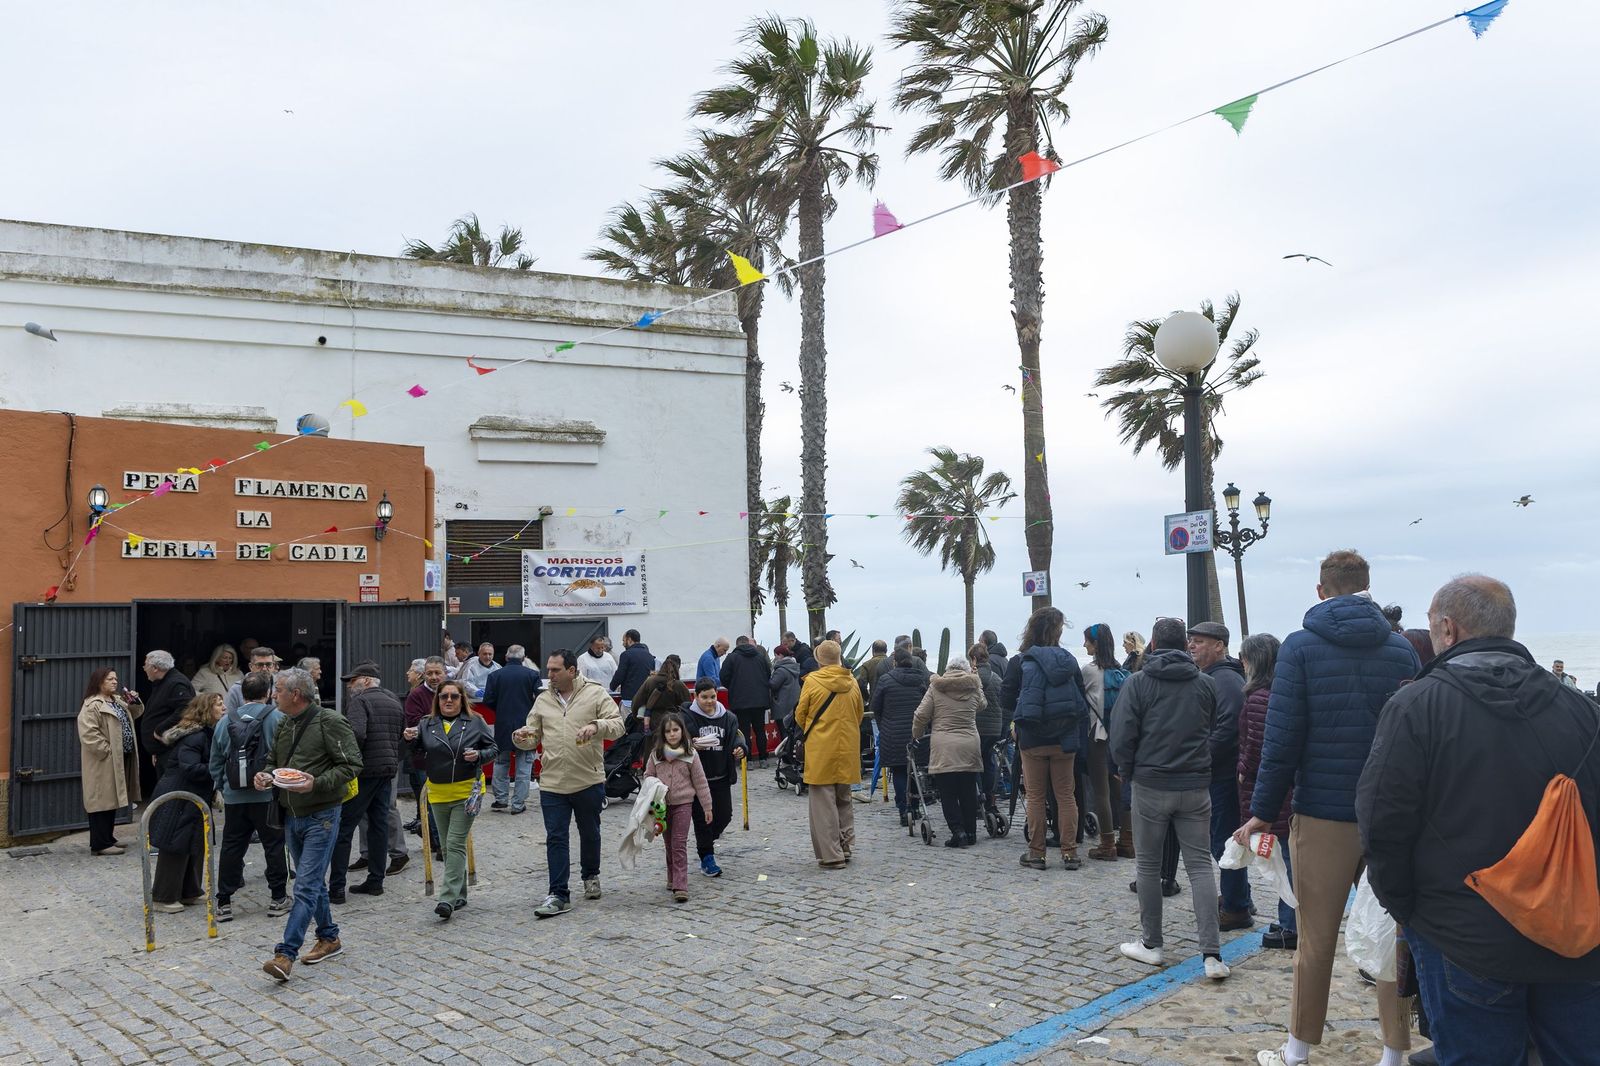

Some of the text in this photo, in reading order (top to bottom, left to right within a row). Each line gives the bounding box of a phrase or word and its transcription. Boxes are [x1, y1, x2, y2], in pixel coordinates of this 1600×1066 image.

[238, 479, 366, 500] FLAMENCA
[238, 512, 270, 526] LA
[124, 542, 366, 560] PERLA DE CADIZ
[547, 557, 624, 565] MARISCOS
[523, 564, 529, 573] 25
[533, 565, 637, 578] CORTEMAR
[640, 564, 646, 572] 25
[523, 574, 529, 583] 25
[641, 573, 647, 582] 25
